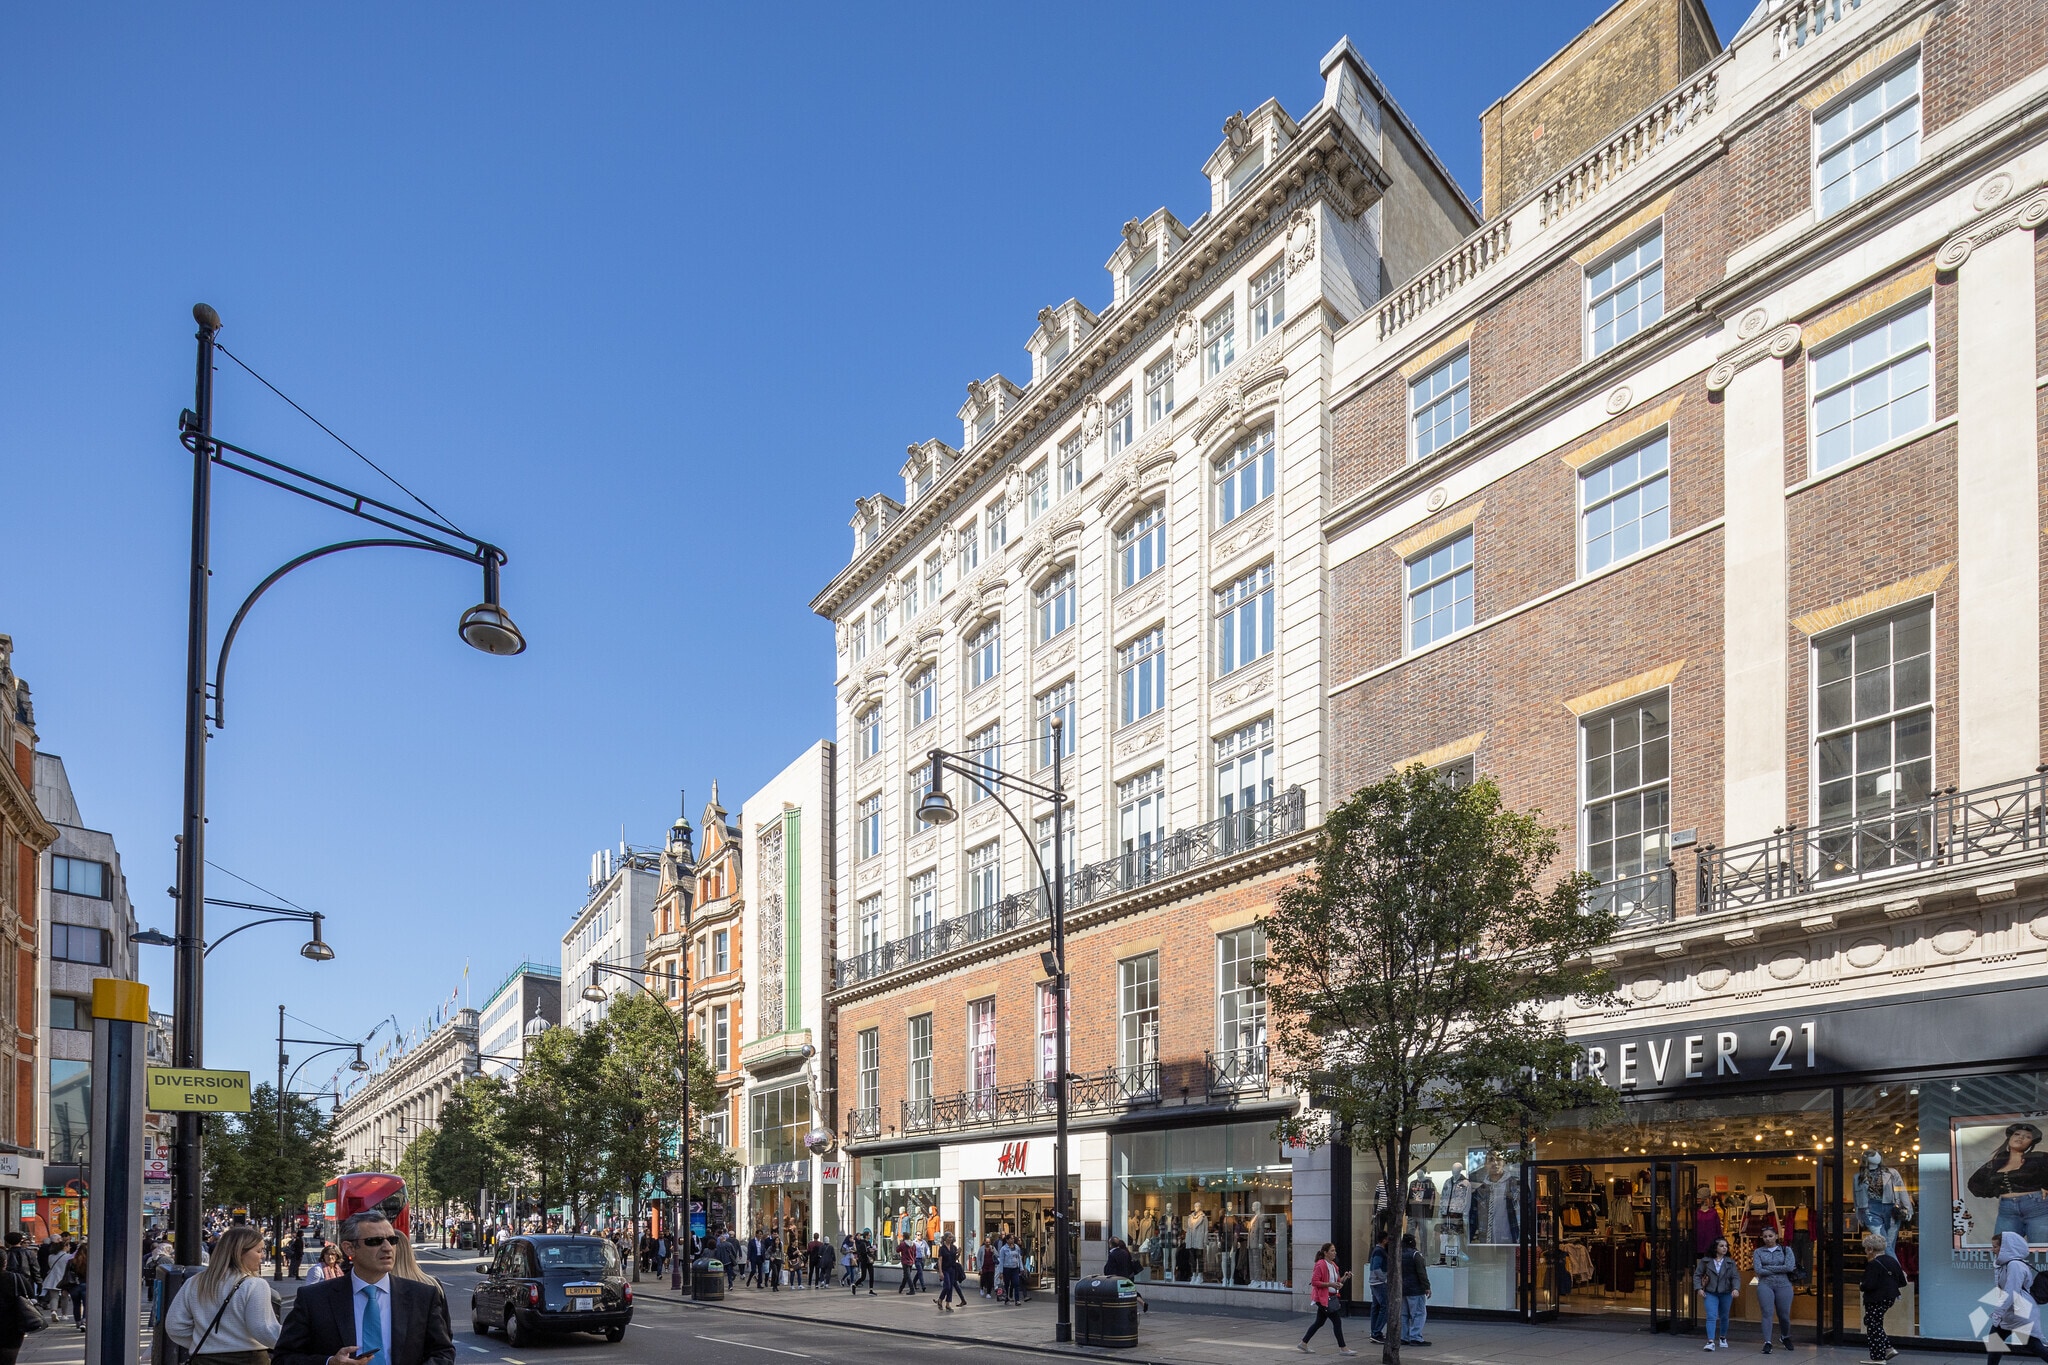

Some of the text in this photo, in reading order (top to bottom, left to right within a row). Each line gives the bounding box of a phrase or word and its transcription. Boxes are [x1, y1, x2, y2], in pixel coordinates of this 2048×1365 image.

[1531, 1021, 1816, 1088] REVER 21
[154, 1075, 244, 1089] DIVERSION
[184, 1094, 218, 1105] END
[998, 1141, 1028, 1174] H&M
[823, 1166, 840, 1180] H&M
[1951, 1262, 1994, 1271] AVAILABLE
